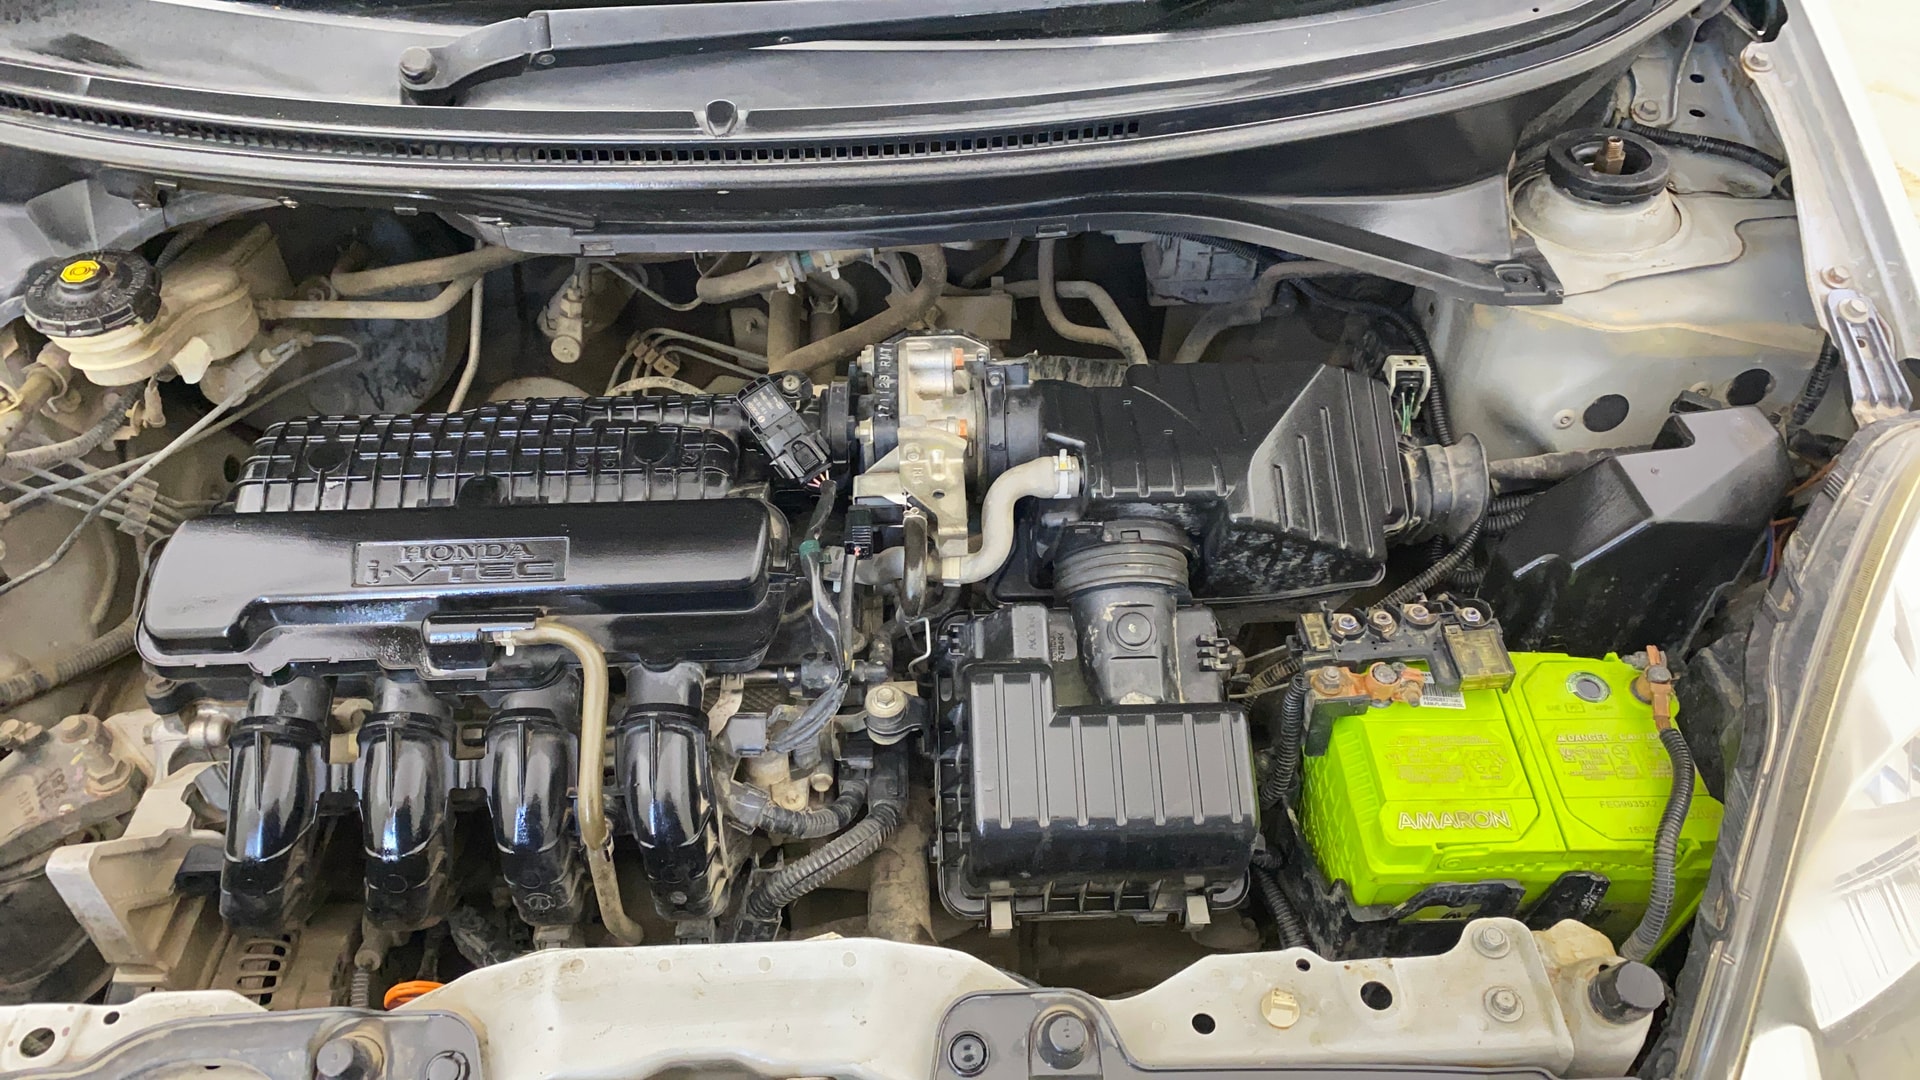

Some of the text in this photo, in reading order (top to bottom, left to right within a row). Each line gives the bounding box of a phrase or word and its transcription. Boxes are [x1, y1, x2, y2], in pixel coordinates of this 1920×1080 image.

[400, 543, 536, 563] HONDA
[365, 558, 556, 585] i-VTEC
[1567, 733, 1609, 741] DANGER
[1398, 810, 1512, 830] AMARON
